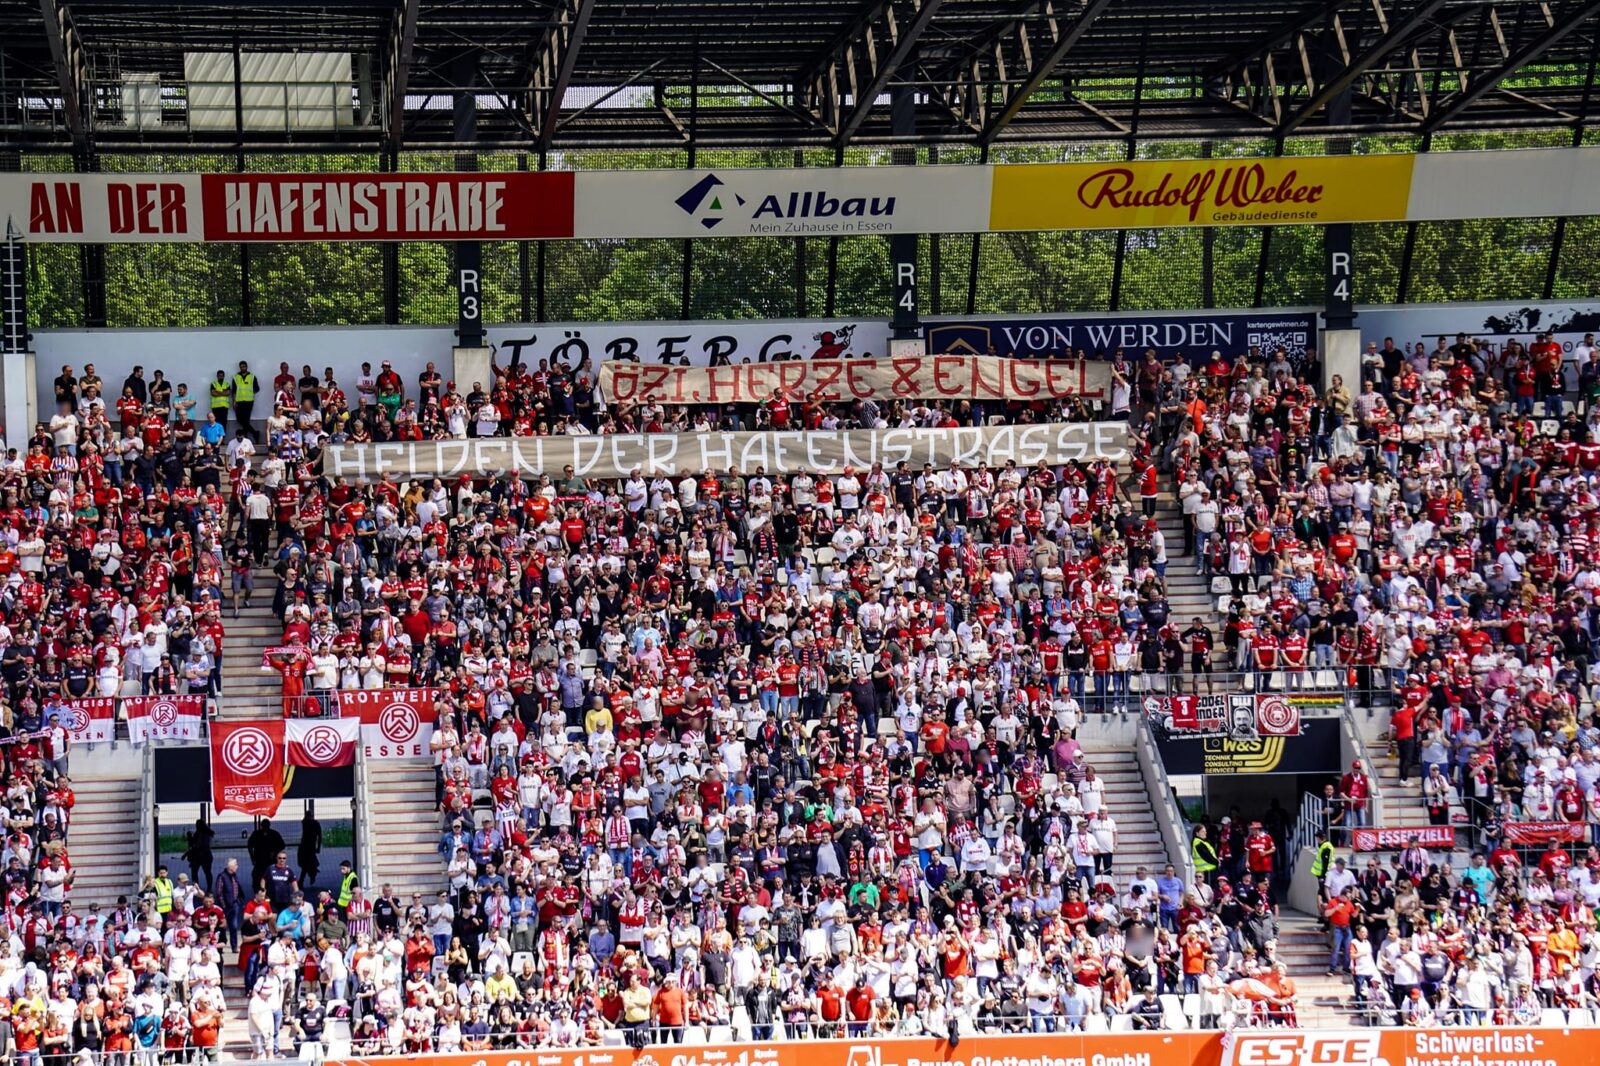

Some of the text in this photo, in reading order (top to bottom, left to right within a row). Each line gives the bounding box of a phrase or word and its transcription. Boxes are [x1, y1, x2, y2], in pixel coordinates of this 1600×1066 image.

[1077, 163, 1324, 221] Rudolf Weber
[29, 182, 84, 234] AN
[108, 182, 188, 234] DER
[752, 191, 896, 219] Allbau
[1212, 209, 1319, 222] Gebäudedienste
[749, 221, 893, 234] Mein Zuhause in Essen
[1002, 321, 1234, 351] VON WERDEN
[1247, 321, 1309, 330] kartengewinnen.de
[892, 357, 922, 398] &
[934, 356, 1104, 399] ENGEL
[332, 421, 1127, 478] HELDEN DER HAFENSTRASSE
[344, 690, 440, 705] ROT-WEIS
[142, 728, 189, 738] ESSEN
[1223, 737, 1262, 752] W&S
[1415, 1031, 1544, 1054] Schwerlast-
